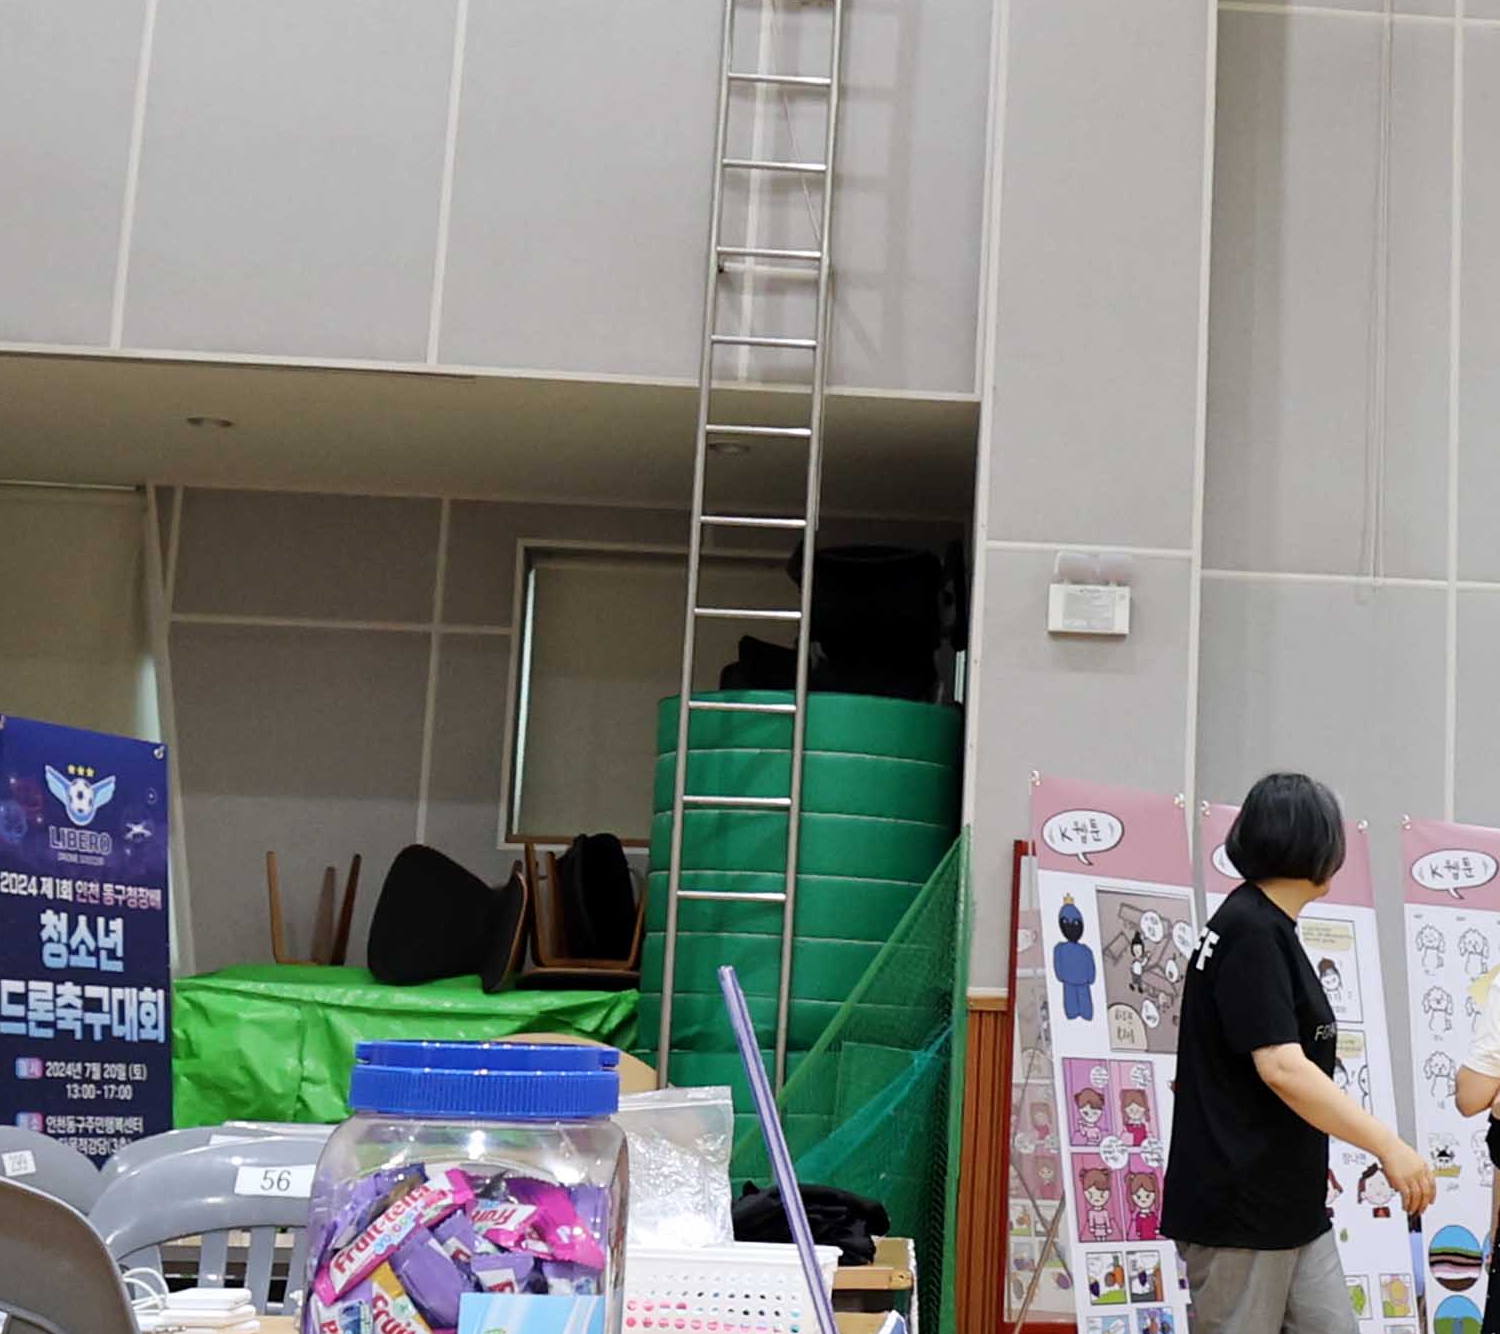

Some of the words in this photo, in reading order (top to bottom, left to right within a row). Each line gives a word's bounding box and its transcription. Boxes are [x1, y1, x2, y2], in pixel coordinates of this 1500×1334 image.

[49, 825, 113, 856] LIBERO
[0, 871, 38, 897] 2024
[75, 879, 100, 904] 인천
[40, 909, 125, 973] 청소년
[0, 978, 166, 1044] 드론축구대회
[45, 1061, 82, 1079] 2024년
[103, 1063, 127, 1081] 20일
[260, 1169, 291, 1192] 56
[333, 1184, 431, 1273] Fruit-tella
